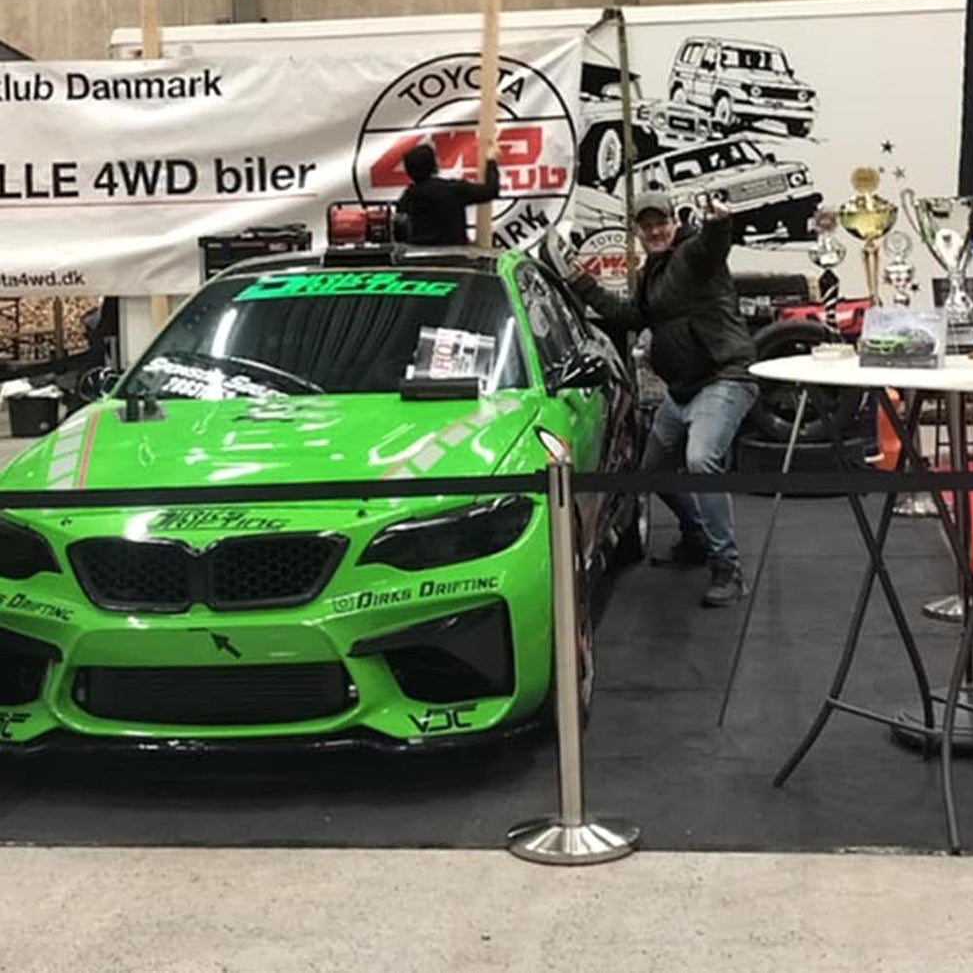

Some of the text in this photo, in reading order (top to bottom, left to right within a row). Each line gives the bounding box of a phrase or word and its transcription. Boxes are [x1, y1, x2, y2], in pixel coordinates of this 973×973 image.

[0, 68, 223, 102] lub Danmark
[0, 156, 317, 199] LLE 4WD biler
[356, 592, 411, 609] DIRKS
